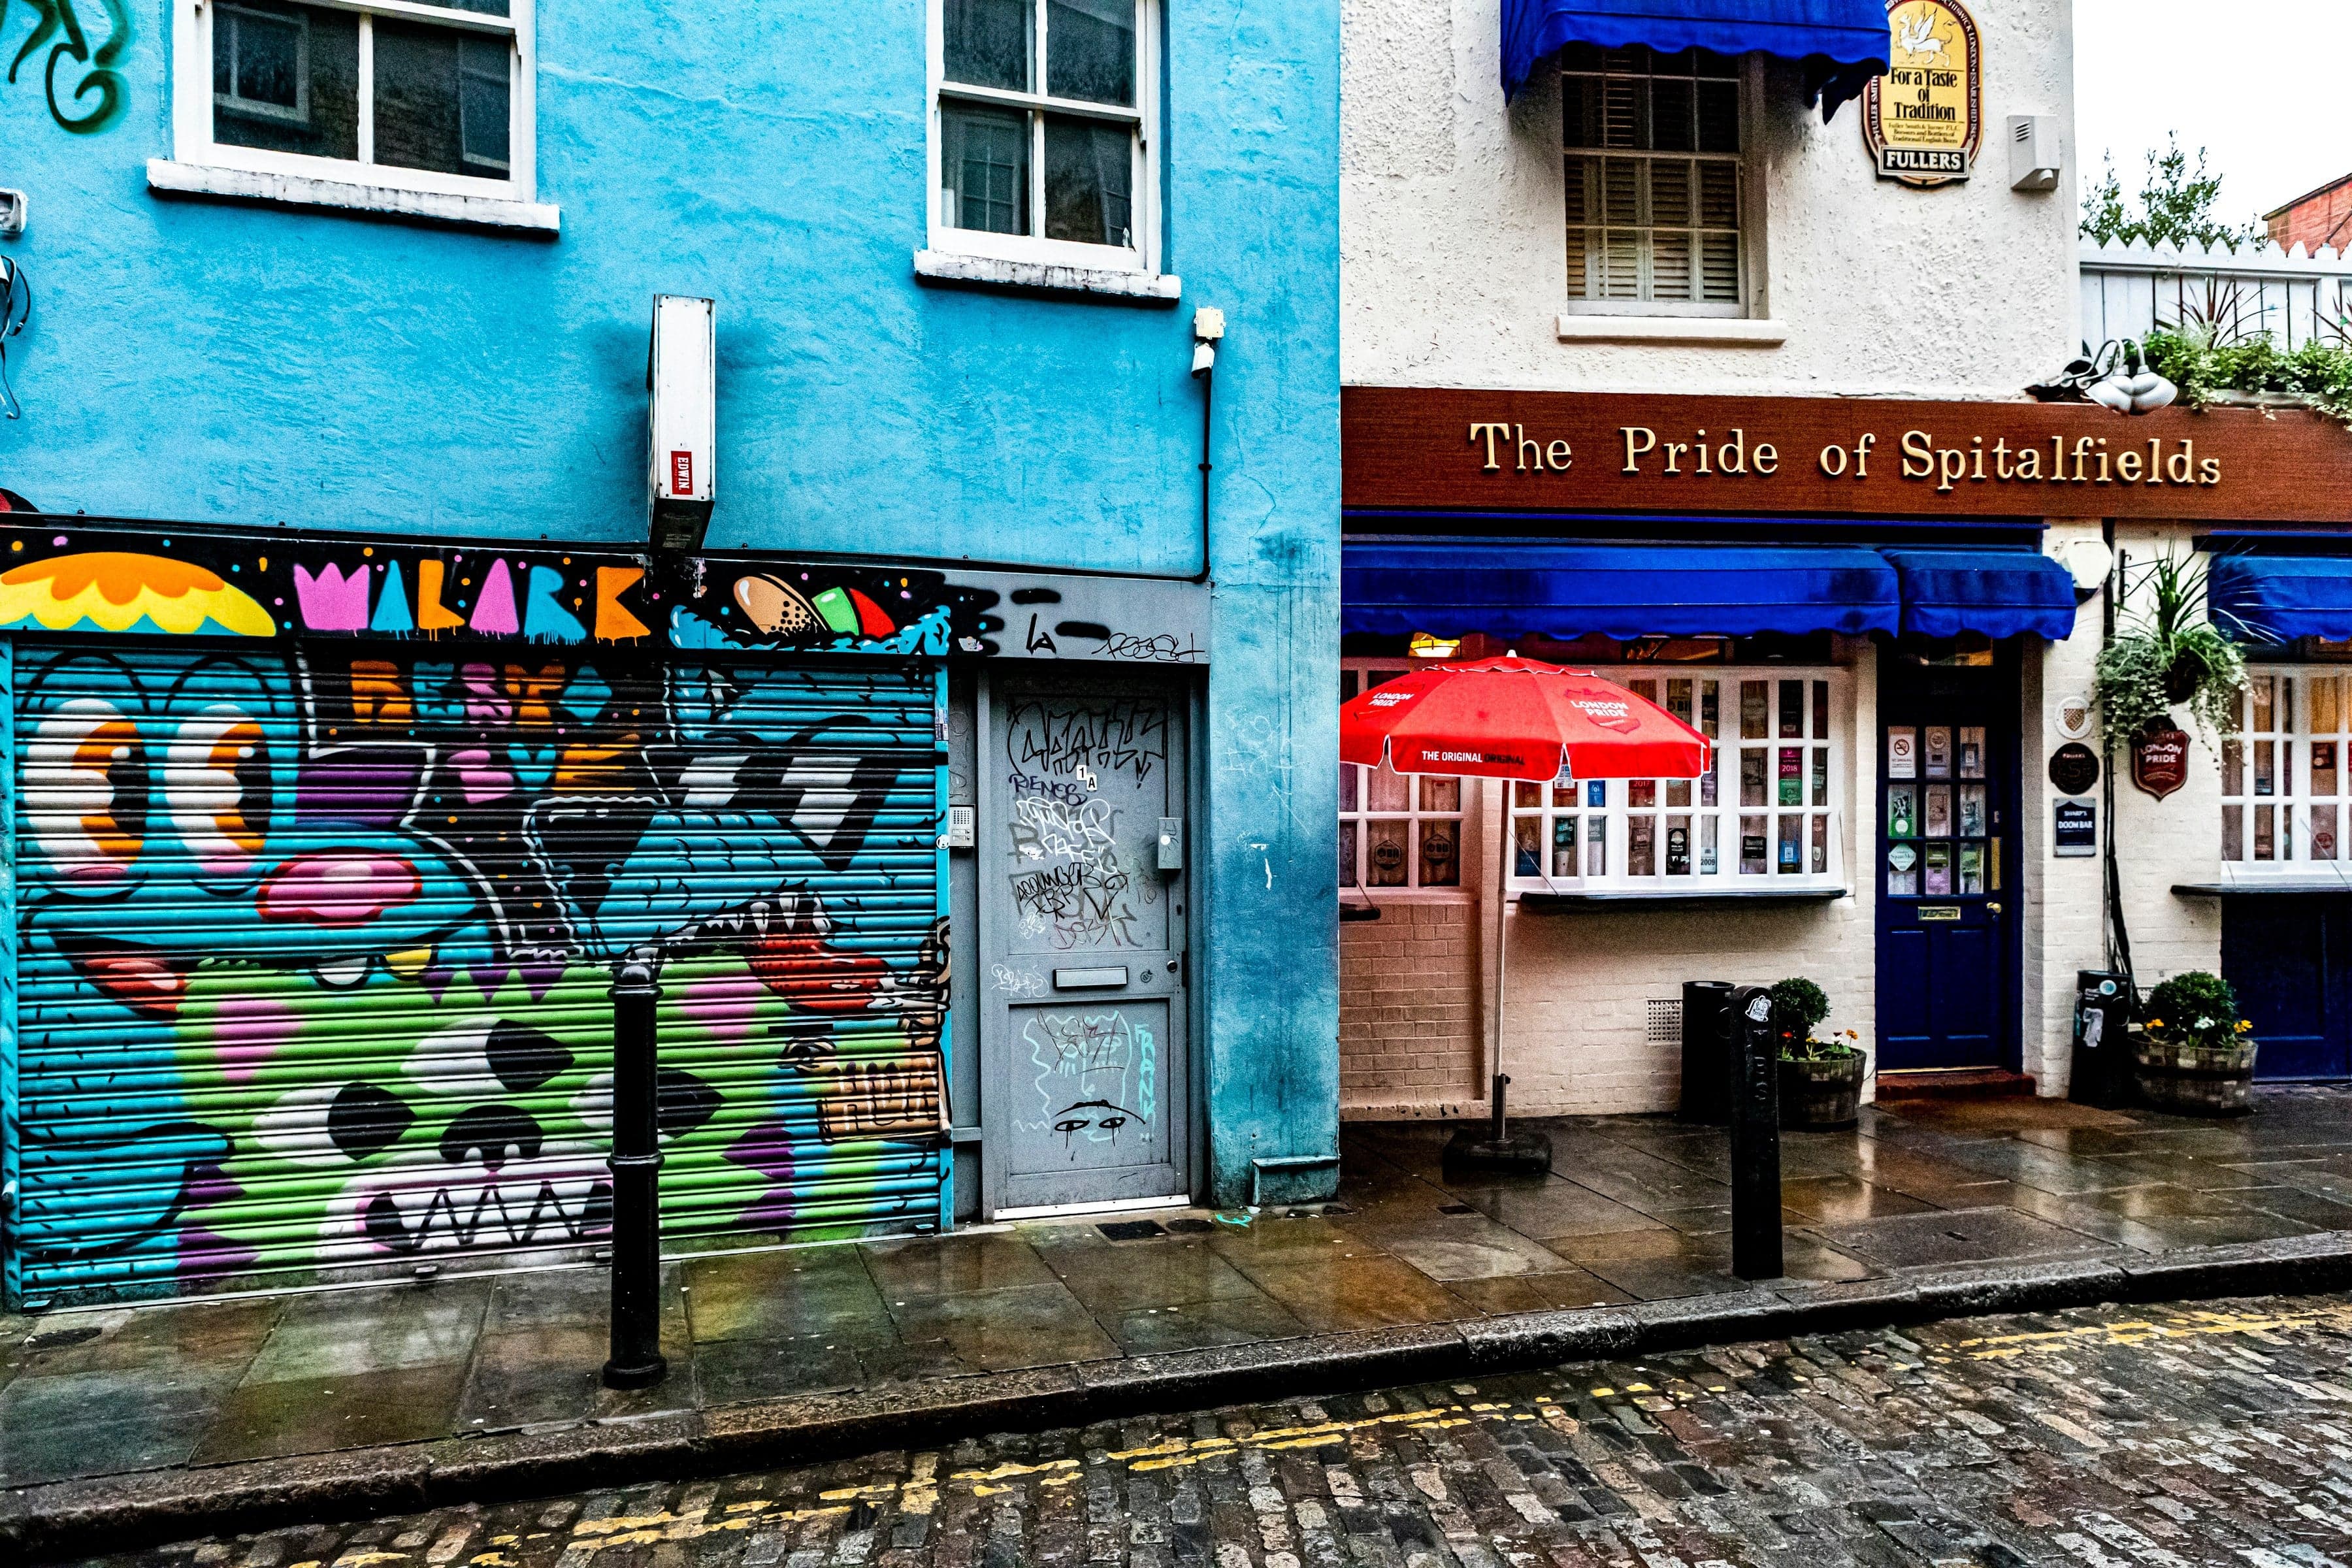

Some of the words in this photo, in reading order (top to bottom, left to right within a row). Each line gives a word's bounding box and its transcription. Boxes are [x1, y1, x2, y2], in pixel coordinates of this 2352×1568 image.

[1891, 68, 1911, 85] For
[1914, 74, 1922, 86] a
[1923, 69, 1957, 88] Taste
[1918, 87, 1930, 103] of
[1894, 102, 1955, 121] Tradition
[1886, 152, 1961, 170] FULLERS
[1470, 423, 1572, 470] The
[1620, 427, 1778, 474] Pride
[1820, 433, 1876, 476] of
[1901, 430, 2222, 491] Spitalfields
[678, 457, 690, 490] EDWIN
[1373, 692, 1415, 700] LONDON
[1570, 700, 1629, 710] LONDON
[1585, 708, 1628, 717] PRIDE
[1422, 750, 1440, 761] THE
[1441, 751, 1483, 763] ORIGINAL
[2145, 754, 2178, 764] PRIDE
[1079, 767, 1085, 778] 1
[1088, 777, 1096, 788] A
[2057, 821, 2079, 829] DOOM
